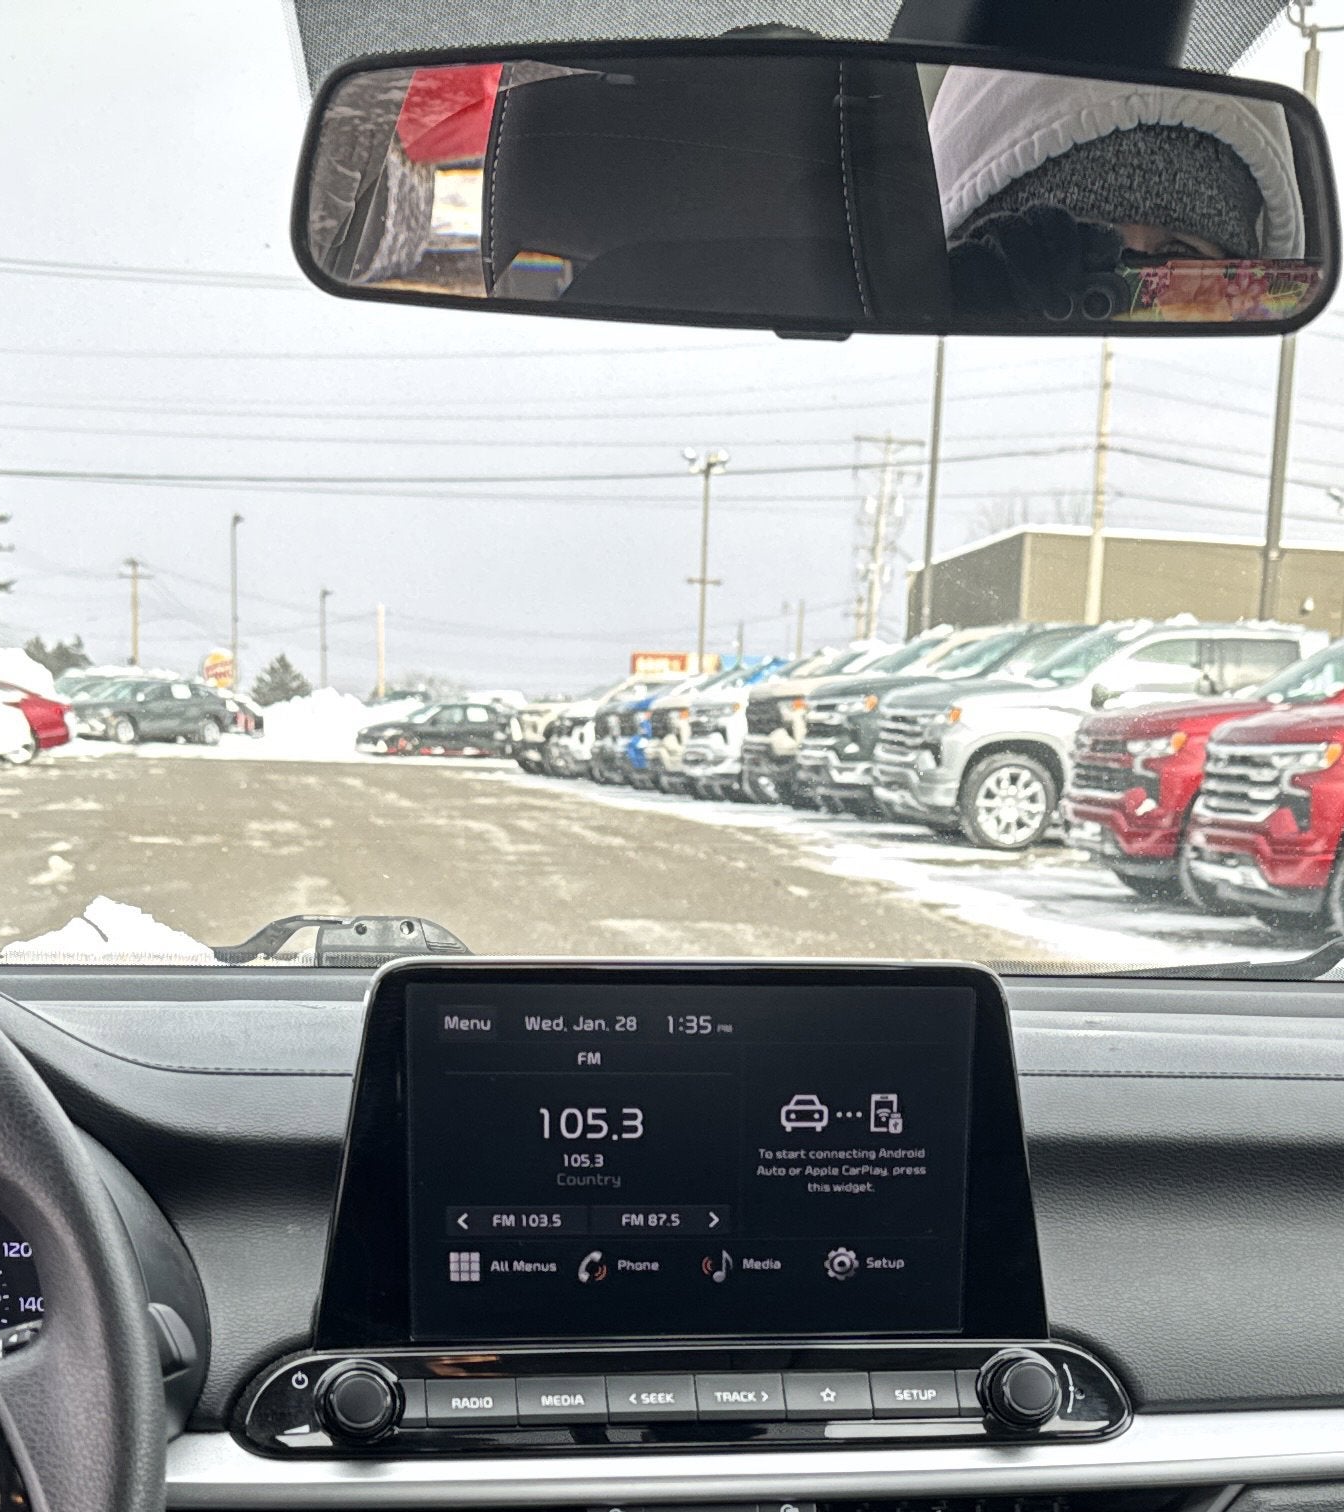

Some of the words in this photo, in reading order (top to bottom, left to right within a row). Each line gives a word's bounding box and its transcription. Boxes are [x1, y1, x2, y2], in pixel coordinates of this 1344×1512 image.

[444, 1015, 491, 1031] Menu
[524, 1015, 568, 1032] Wed.
[572, 1016, 610, 1032] Jan.
[614, 1016, 637, 1032] 28
[667, 1015, 712, 1034] 1:35
[577, 1051, 601, 1065] FM
[539, 1107, 644, 1141] 105.3
[563, 1153, 604, 1168] 105.3
[758, 1148, 774, 1160] To
[775, 1149, 806, 1160] start
[808, 1148, 877, 1161] connecting
[878, 1147, 926, 1159] Android
[756, 1165, 787, 1177] Auto
[788, 1167, 803, 1177] or
[805, 1165, 839, 1178] Apple
[892, 1166, 927, 1178] press
[556, 1172, 621, 1188] Country
[807, 1182, 831, 1193] this
[492, 1214, 516, 1227] FM
[521, 1213, 562, 1228] 103.5
[621, 1213, 644, 1226] FM
[647, 1213, 681, 1227] 87.5
[2, 1242, 33, 1258] 120
[489, 1259, 510, 1273] All
[511, 1259, 557, 1273] Menus
[617, 1259, 660, 1271] Phone
[742, 1258, 782, 1270] Media
[866, 1256, 905, 1270] Setup
[540, 1394, 585, 1407] MEDIA
[640, 1392, 675, 1405] SEEK
[714, 1391, 757, 1403] TRACK
[894, 1389, 937, 1401] SETUP
[451, 1396, 494, 1410] RADIO
